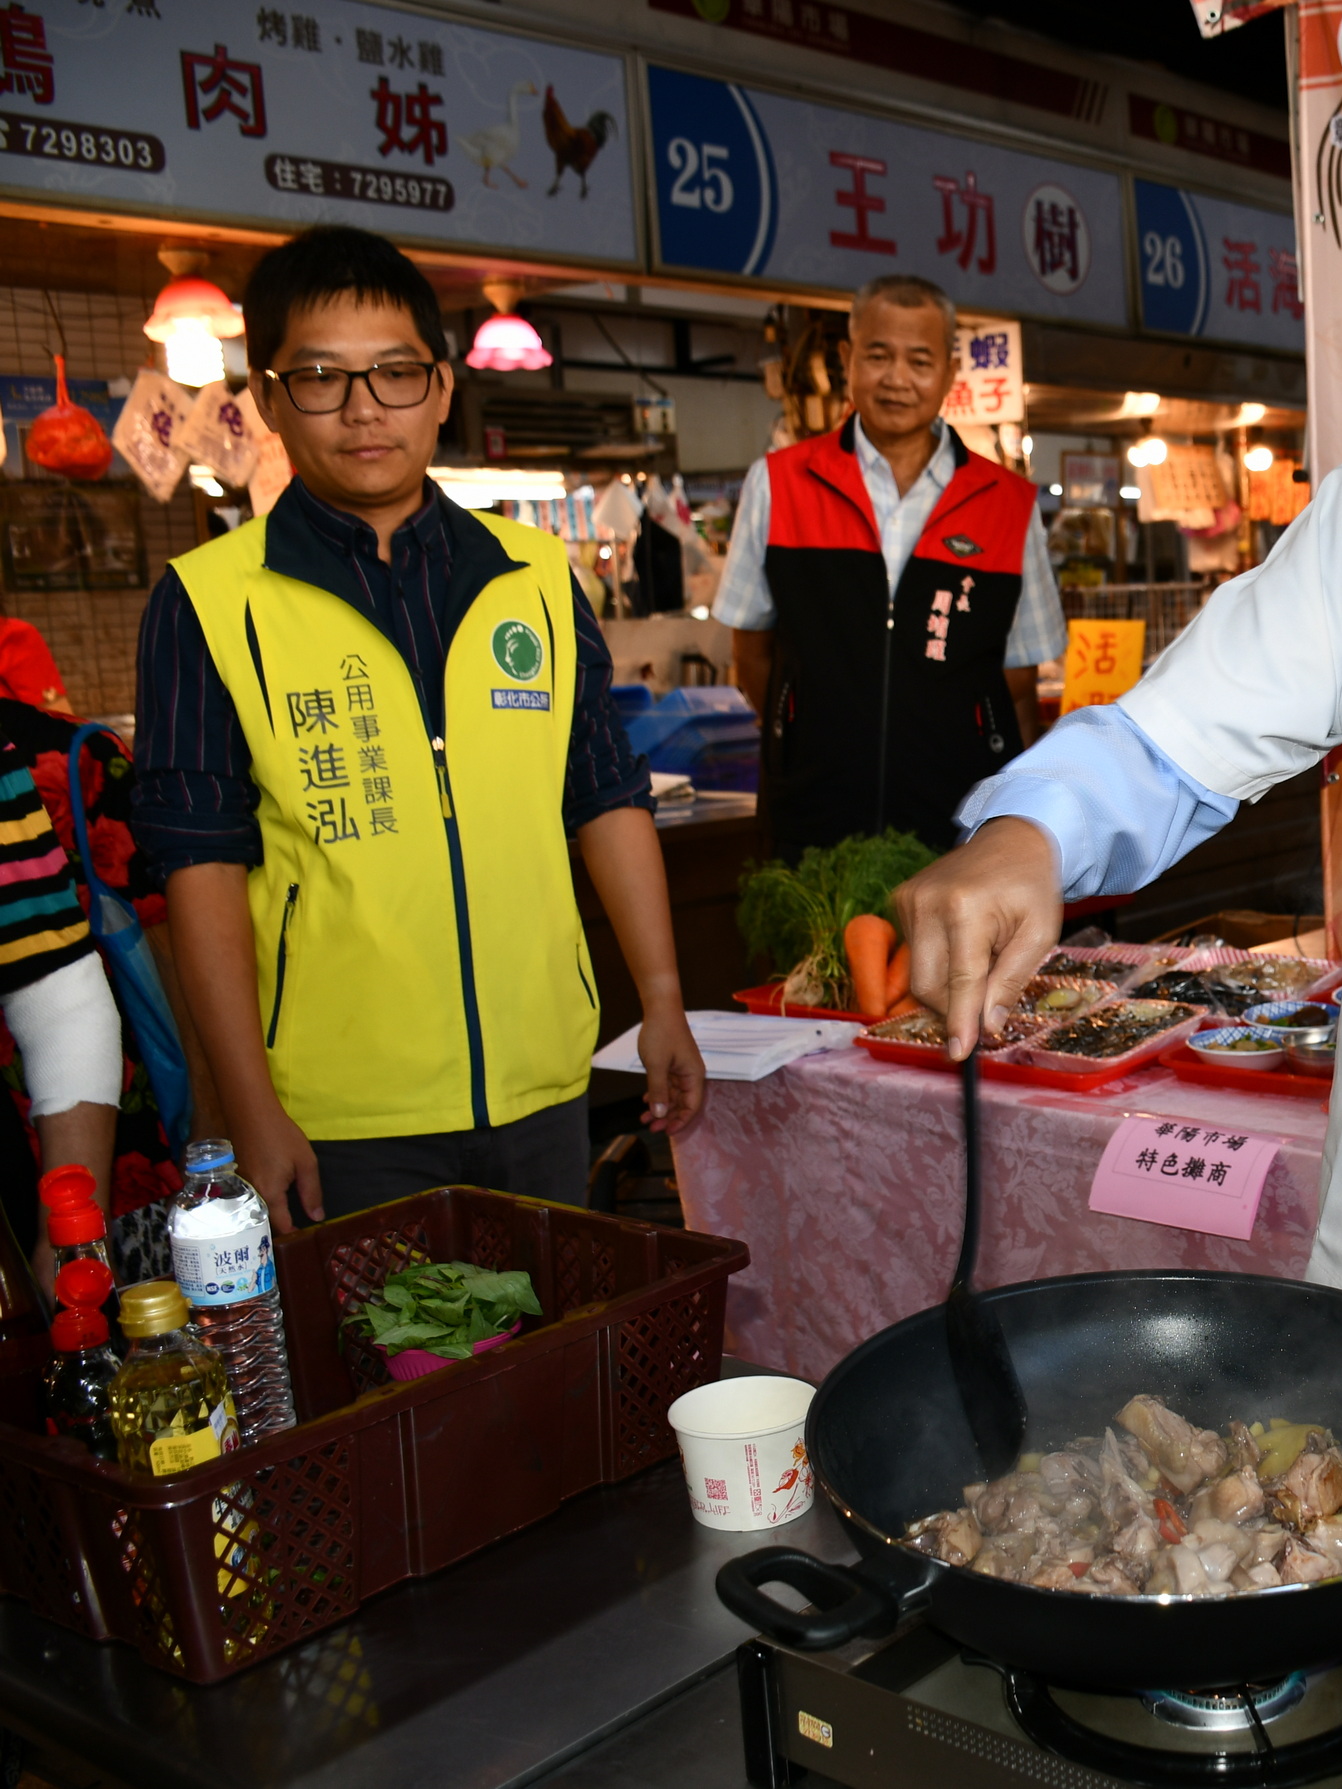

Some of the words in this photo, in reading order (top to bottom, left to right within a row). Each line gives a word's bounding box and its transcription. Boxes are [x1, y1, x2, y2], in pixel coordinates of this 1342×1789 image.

[20, 123, 153, 169] 7298303
[667, 137, 735, 214] 25
[1144, 230, 1186, 290] 26
[944, 376, 1013, 418] 魚子
[1072, 631, 1118, 680] 活
[493, 690, 550, 709] 彰化市公所
[286, 688, 362, 845] 陳進泓
[340, 653, 399, 837] 公用事業課長
[1154, 1122, 1249, 1152] 華陽市場
[1135, 1147, 1232, 1187] 特色攤商
[214, 1246, 249, 1266] 波爾
